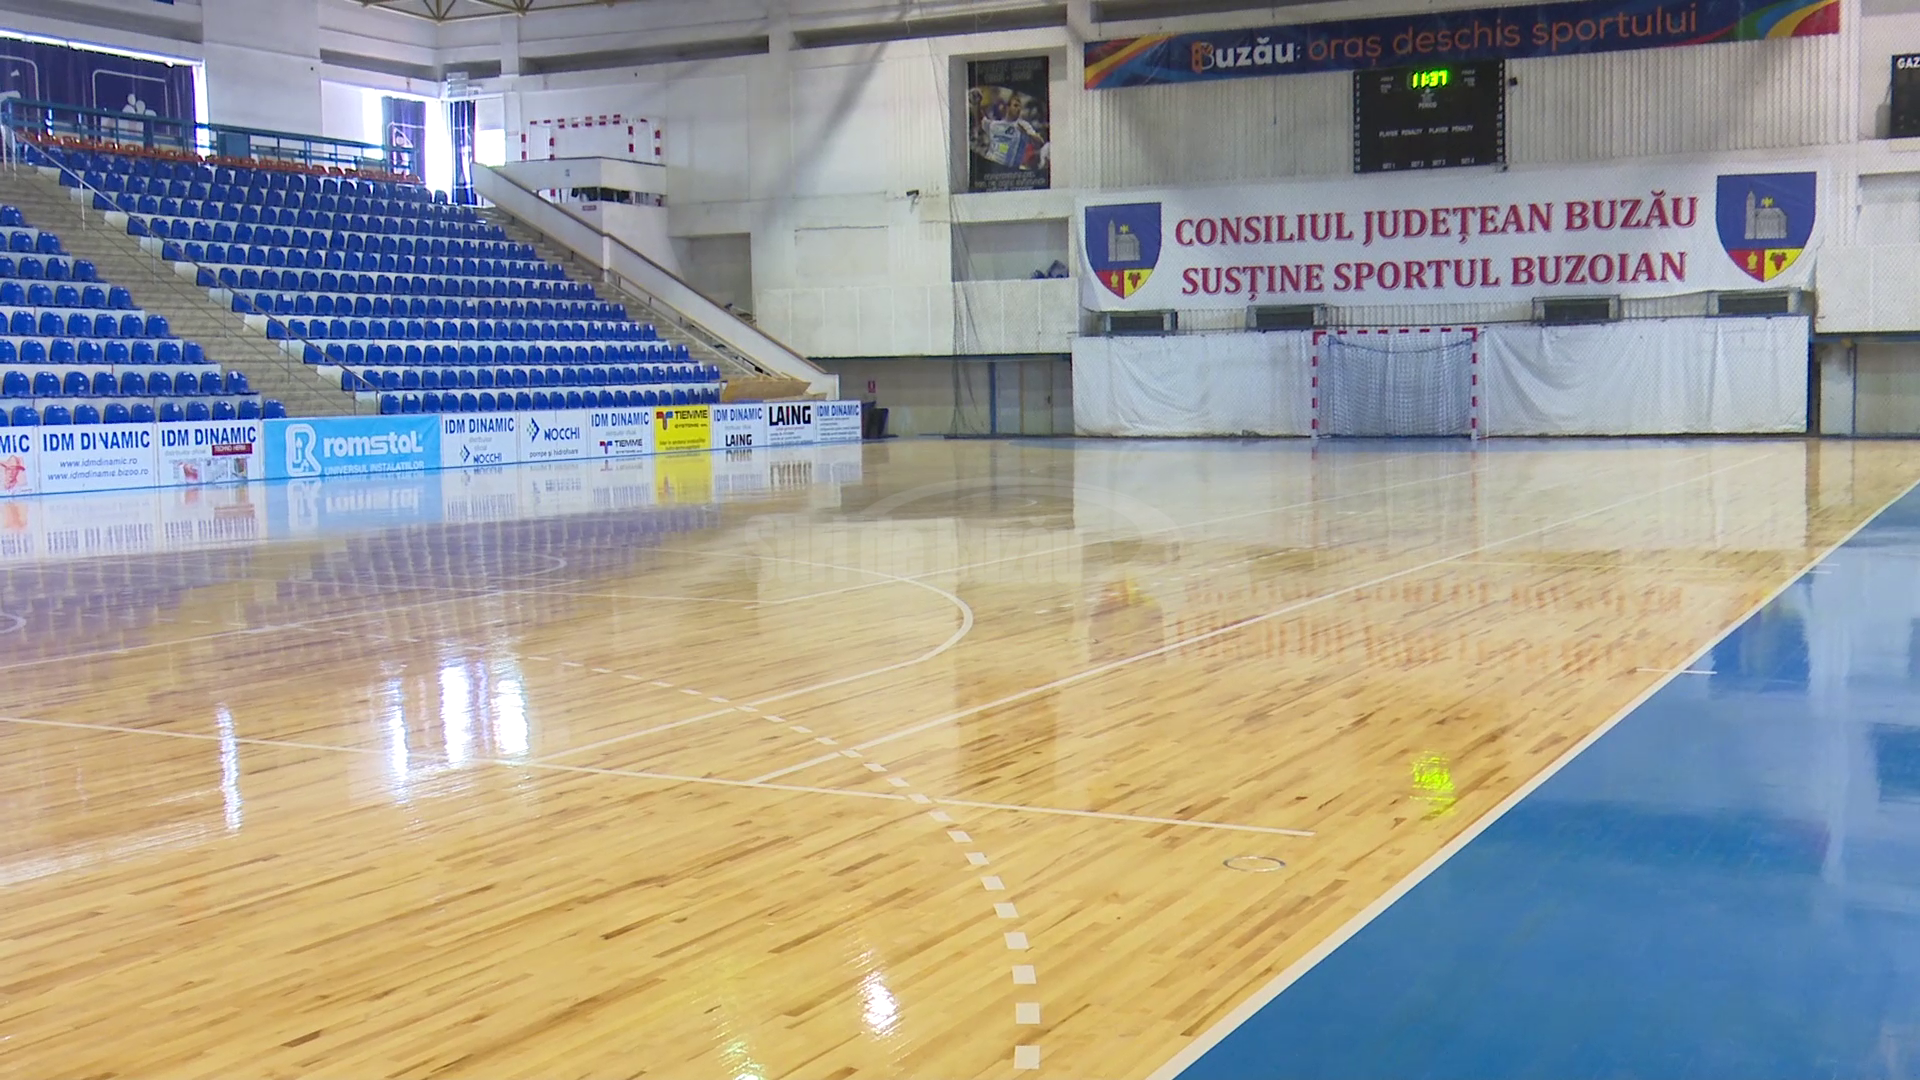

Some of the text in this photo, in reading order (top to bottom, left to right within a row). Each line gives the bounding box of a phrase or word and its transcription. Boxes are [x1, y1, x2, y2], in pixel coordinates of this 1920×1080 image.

[1191, 3, 1697, 73] Buzău: oraș deschis sportului
[1411, 70, 1449, 89] 11:37
[1401, 128, 1423, 136] PENALTY
[1175, 189, 1698, 246] CONSILIUL JUDEȚEAN BUZĂU
[1182, 252, 1686, 301] SUSȚINE SPORTUL BUZOIAN
[674, 410, 708, 419] TIEMME
[713, 407, 763, 422] IDM DINAMIC
[768, 405, 811, 426] LAING
[816, 404, 860, 417] IDM DINAMIC
[445, 417, 515, 434] IDM DINAMIC
[591, 412, 650, 427] IDM DINAMIC
[43, 430, 151, 452] IDM DINAMIC
[161, 426, 256, 447] IDM DINAMIC
[544, 427, 580, 441] NOCCHI
[725, 434, 753, 447] LAING
[614, 439, 643, 447] TIEMME
[473, 452, 502, 464] NOCCHI
[324, 464, 369, 476] UNIVERSUL
